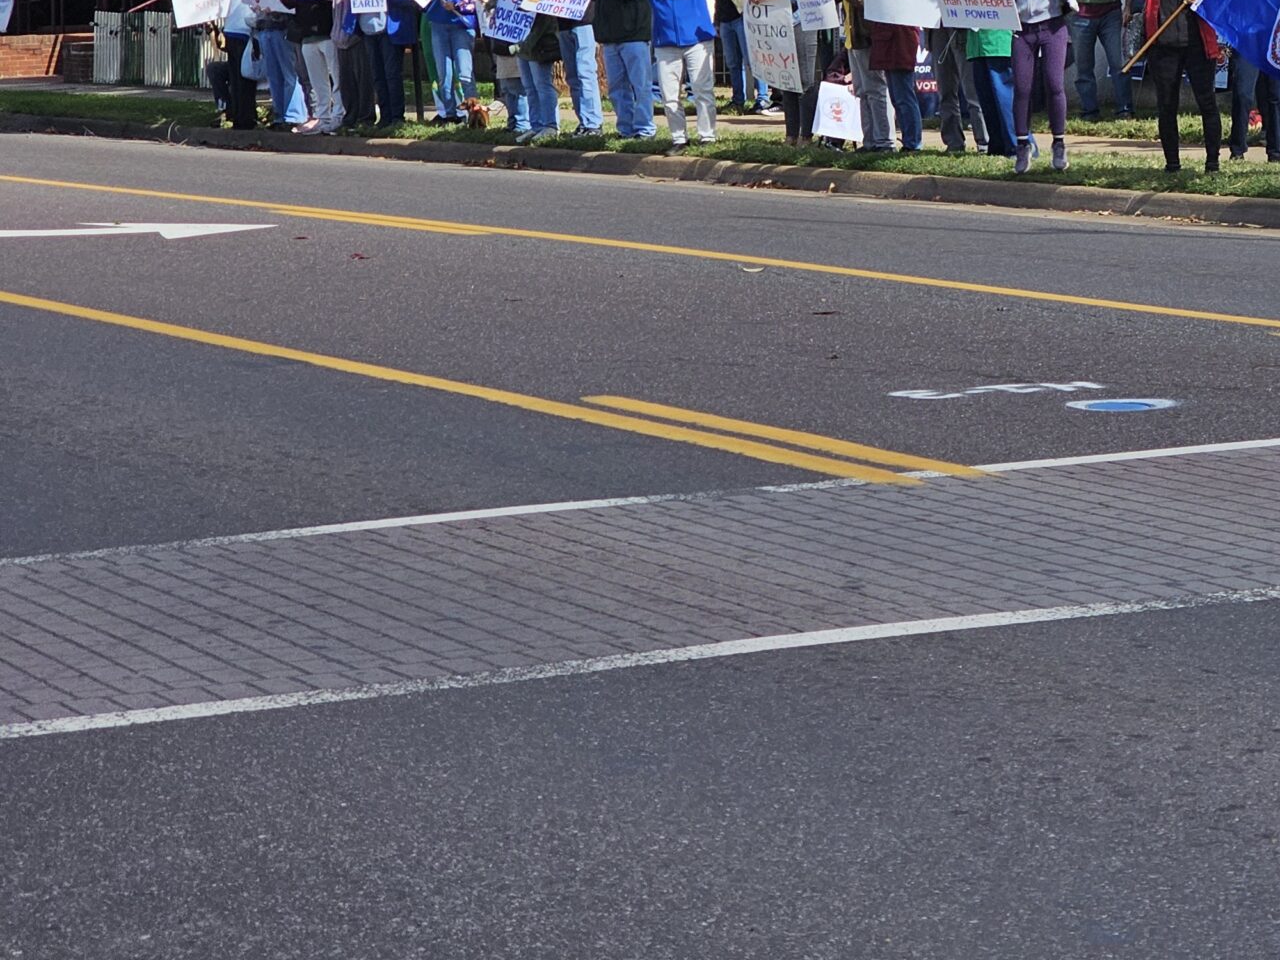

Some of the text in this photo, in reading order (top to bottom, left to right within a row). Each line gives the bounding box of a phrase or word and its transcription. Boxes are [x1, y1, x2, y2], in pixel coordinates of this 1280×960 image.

[536, 3, 584, 18] OUT OF THIS
[947, 9, 1000, 20] IN POWER
[915, 81, 938, 90] VOT
